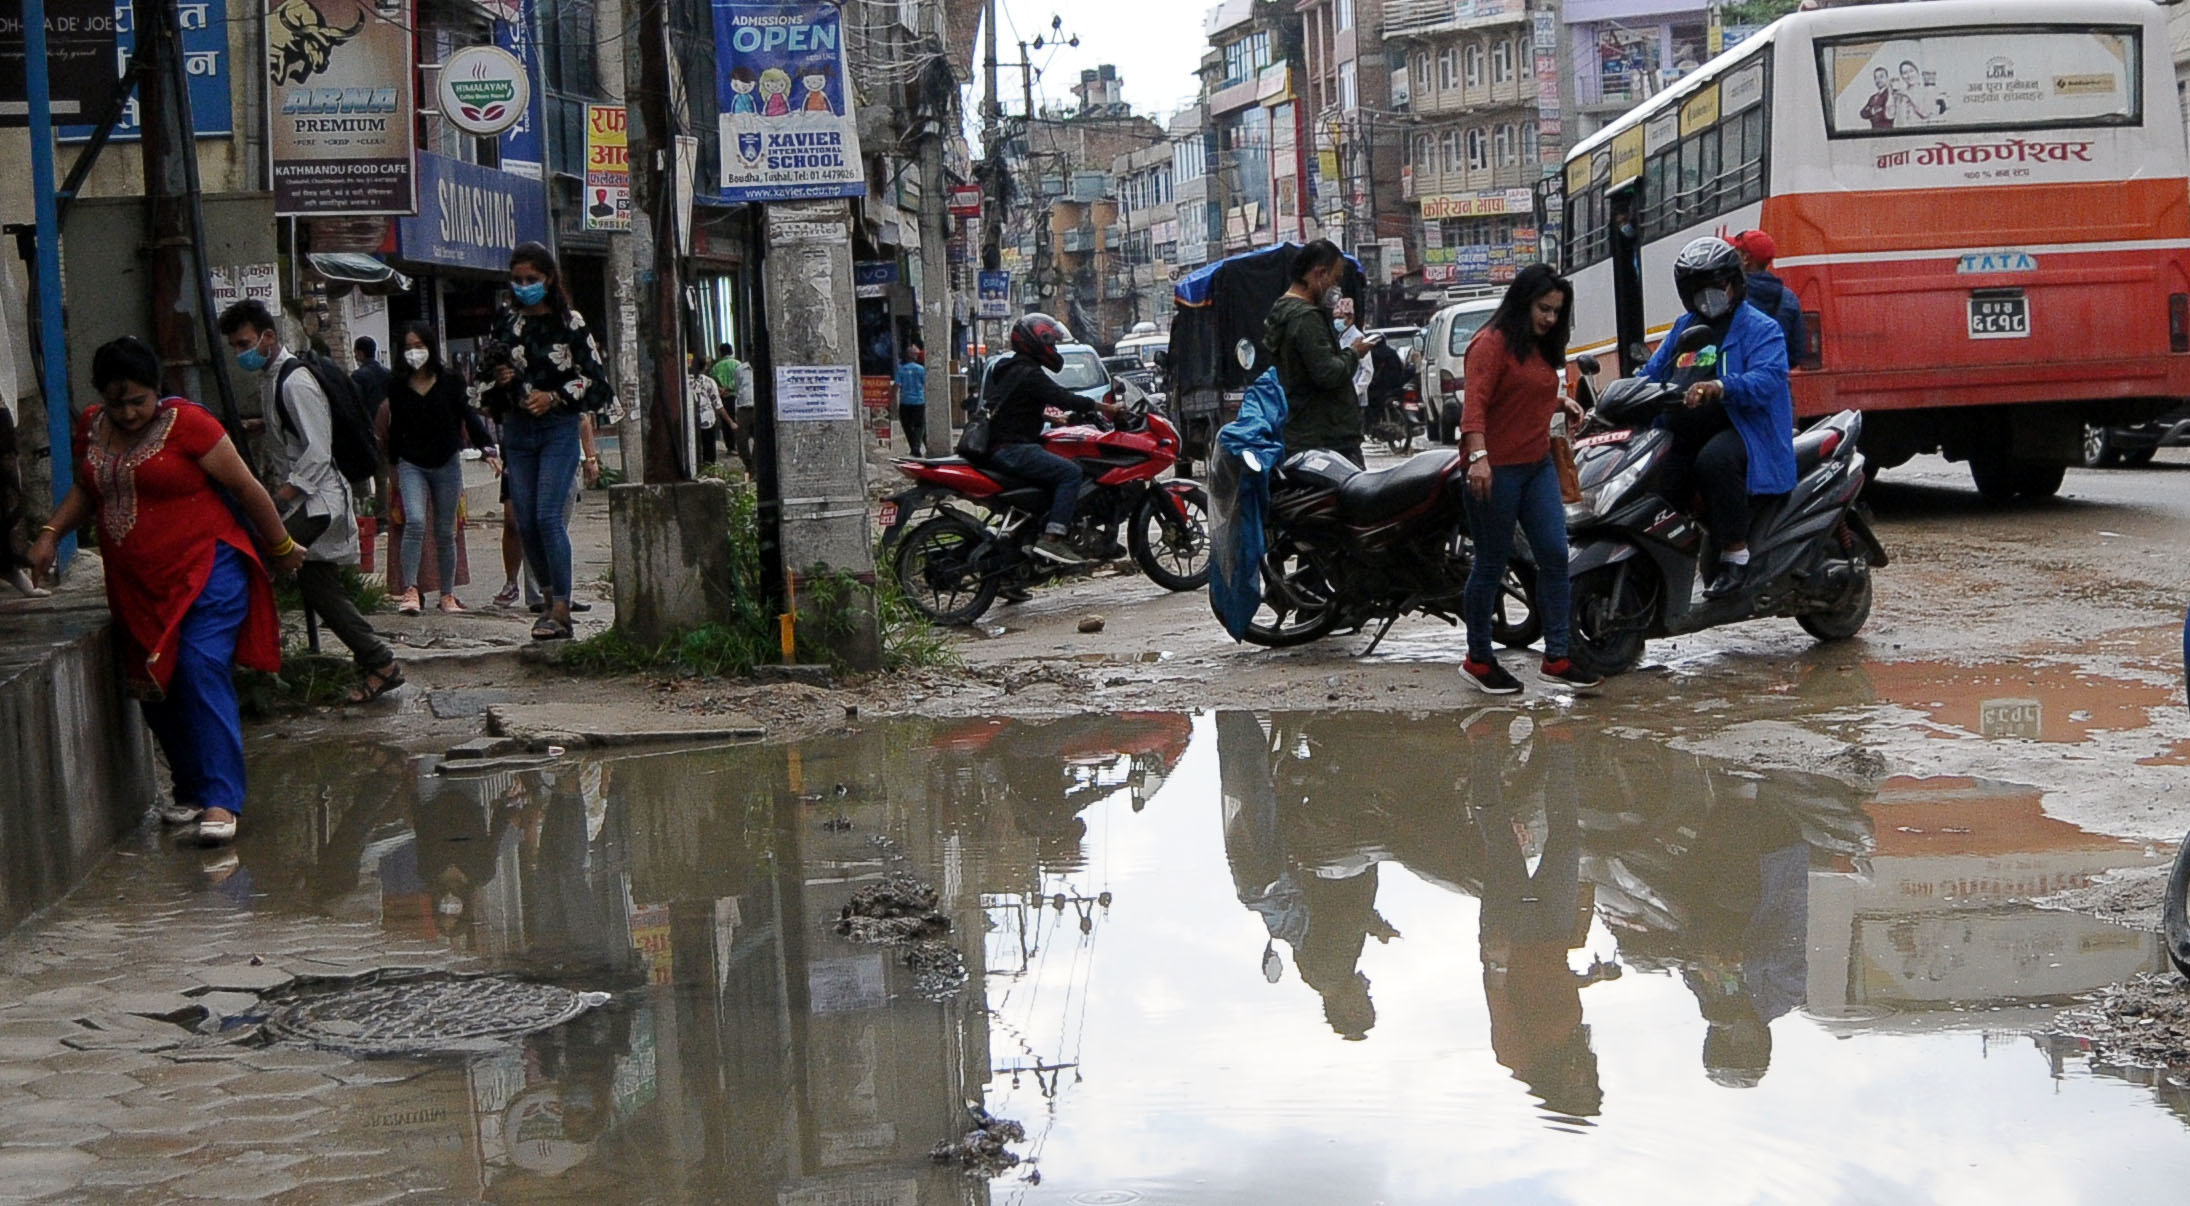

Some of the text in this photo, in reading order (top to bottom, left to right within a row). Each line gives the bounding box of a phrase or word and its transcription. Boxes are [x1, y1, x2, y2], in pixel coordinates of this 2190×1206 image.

[58, 17, 80, 31] DE'
[84, 16, 112, 31] JOE
[732, 15, 803, 26] ADMISSIONS
[733, 24, 836, 52] OPEN
[456, 83, 508, 92] HIMALAYAN
[282, 88, 398, 114] ARNA
[295, 118, 386, 132] PREMIUM
[768, 131, 841, 148] XAVIER
[768, 146, 842, 155] INTERNATIONAL
[768, 153, 844, 169] SCHOOL
[1876, 150, 1911, 169] बाबा
[275, 164, 407, 176] KATHMANDU FOOD CAFE
[728, 173, 763, 184] Boudha,
[794, 170, 809, 180] Tel:
[745, 185, 841, 198] www.xavier.edu.np
[1508, 189, 1530, 198] JAPAN
[438, 177, 516, 250] SAMSUNG
[1963, 253, 2030, 270] TATA
